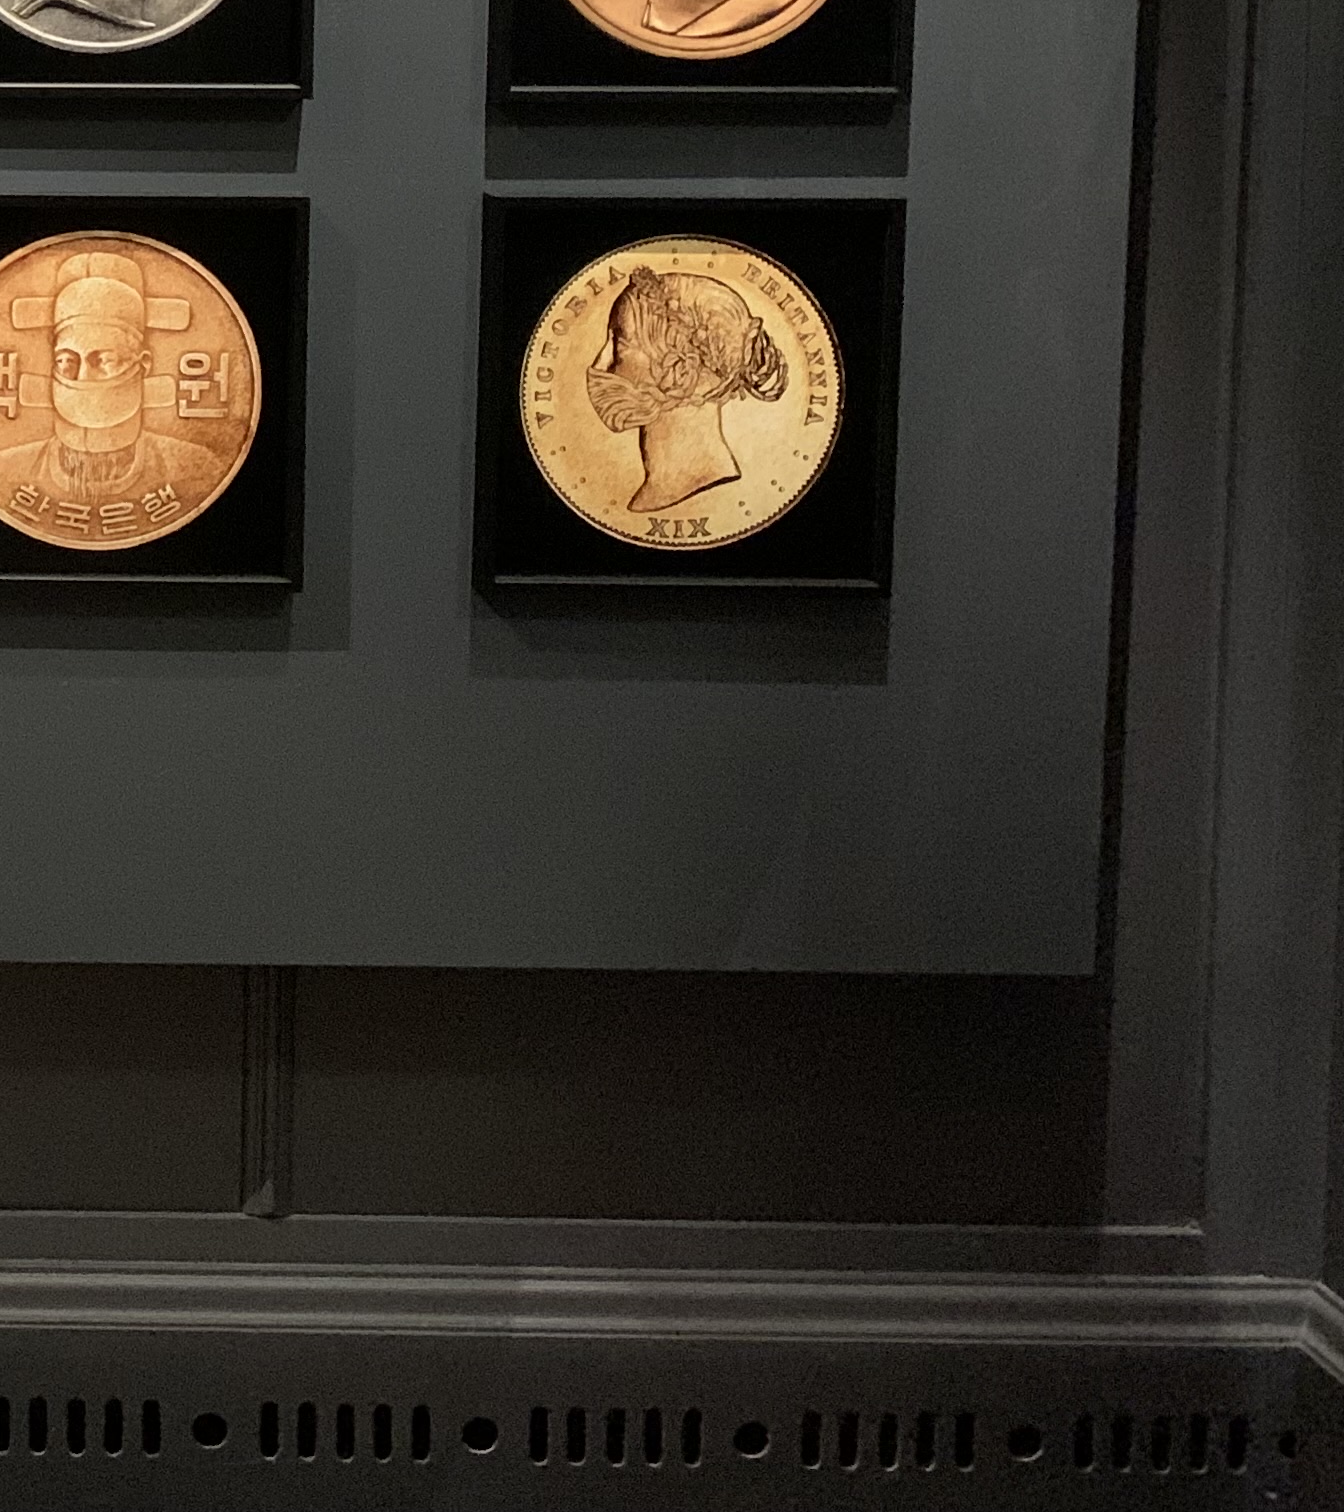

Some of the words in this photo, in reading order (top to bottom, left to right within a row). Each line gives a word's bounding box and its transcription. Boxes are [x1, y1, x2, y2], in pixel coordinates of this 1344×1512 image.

[534, 266, 626, 430] VICTORIA
[741, 262, 828, 426] BRITANNIA
[178, 351, 230, 419] 원
[9, 483, 183, 536] 한국은행
[645, 516, 712, 539] XIX
